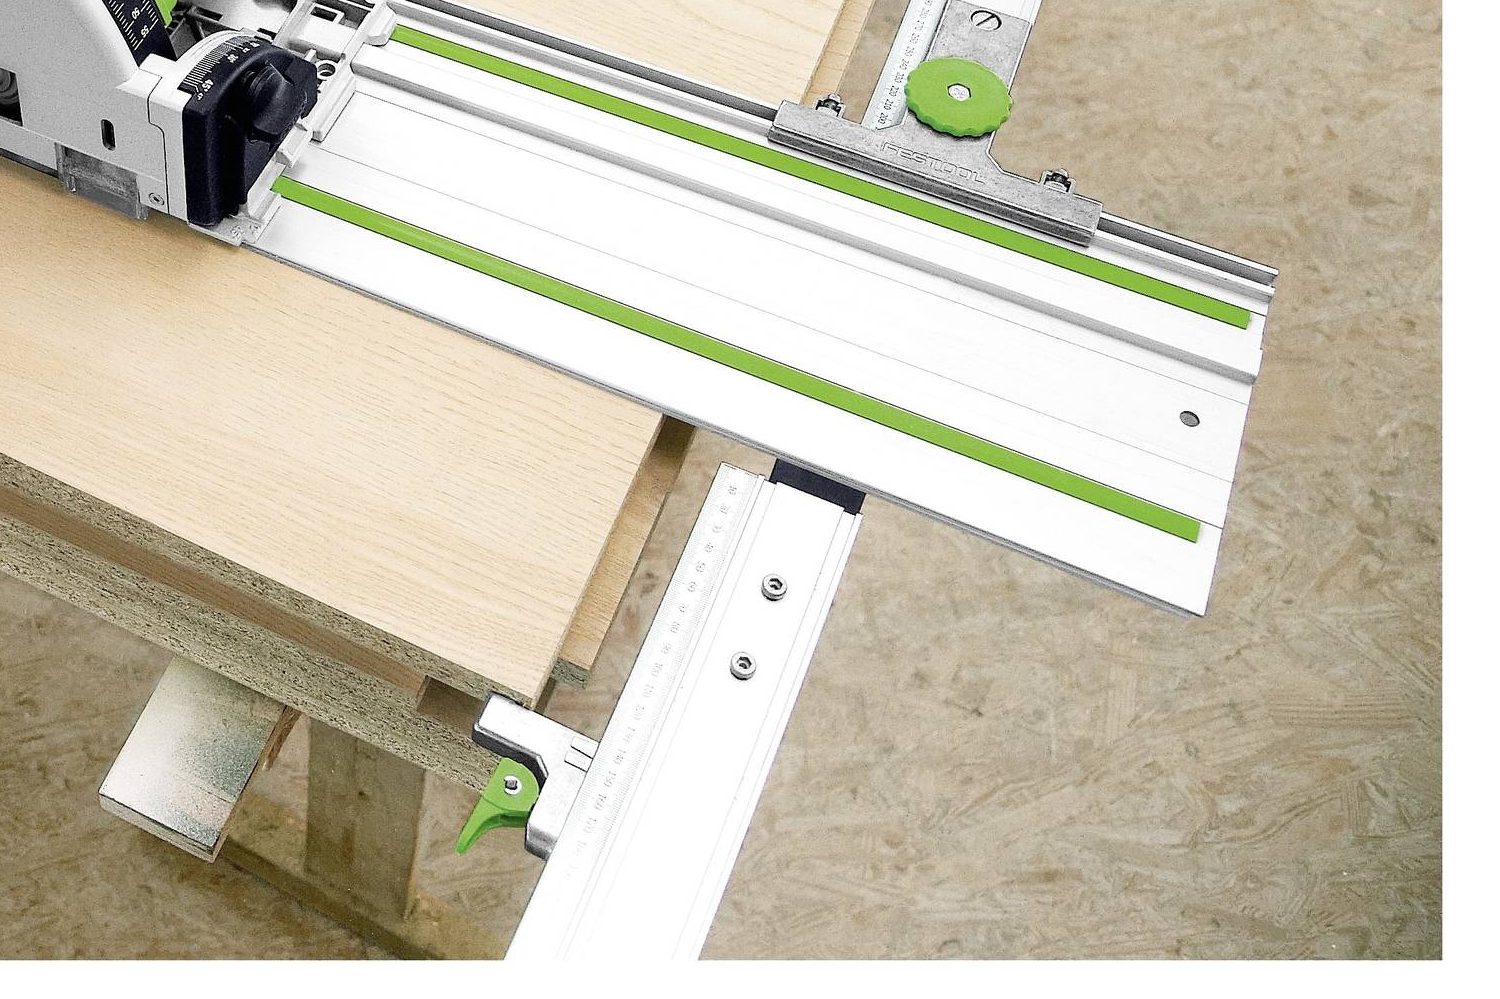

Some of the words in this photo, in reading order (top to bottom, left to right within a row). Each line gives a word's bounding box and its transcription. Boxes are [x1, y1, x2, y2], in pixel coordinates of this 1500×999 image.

[131, 6, 140, 20] 50
[140, 24, 150, 38] 55
[888, 85, 899, 97] 220
[883, 98, 894, 111] 210
[877, 112, 889, 125] 200
[882, 141, 986, 184] FESTOOL
